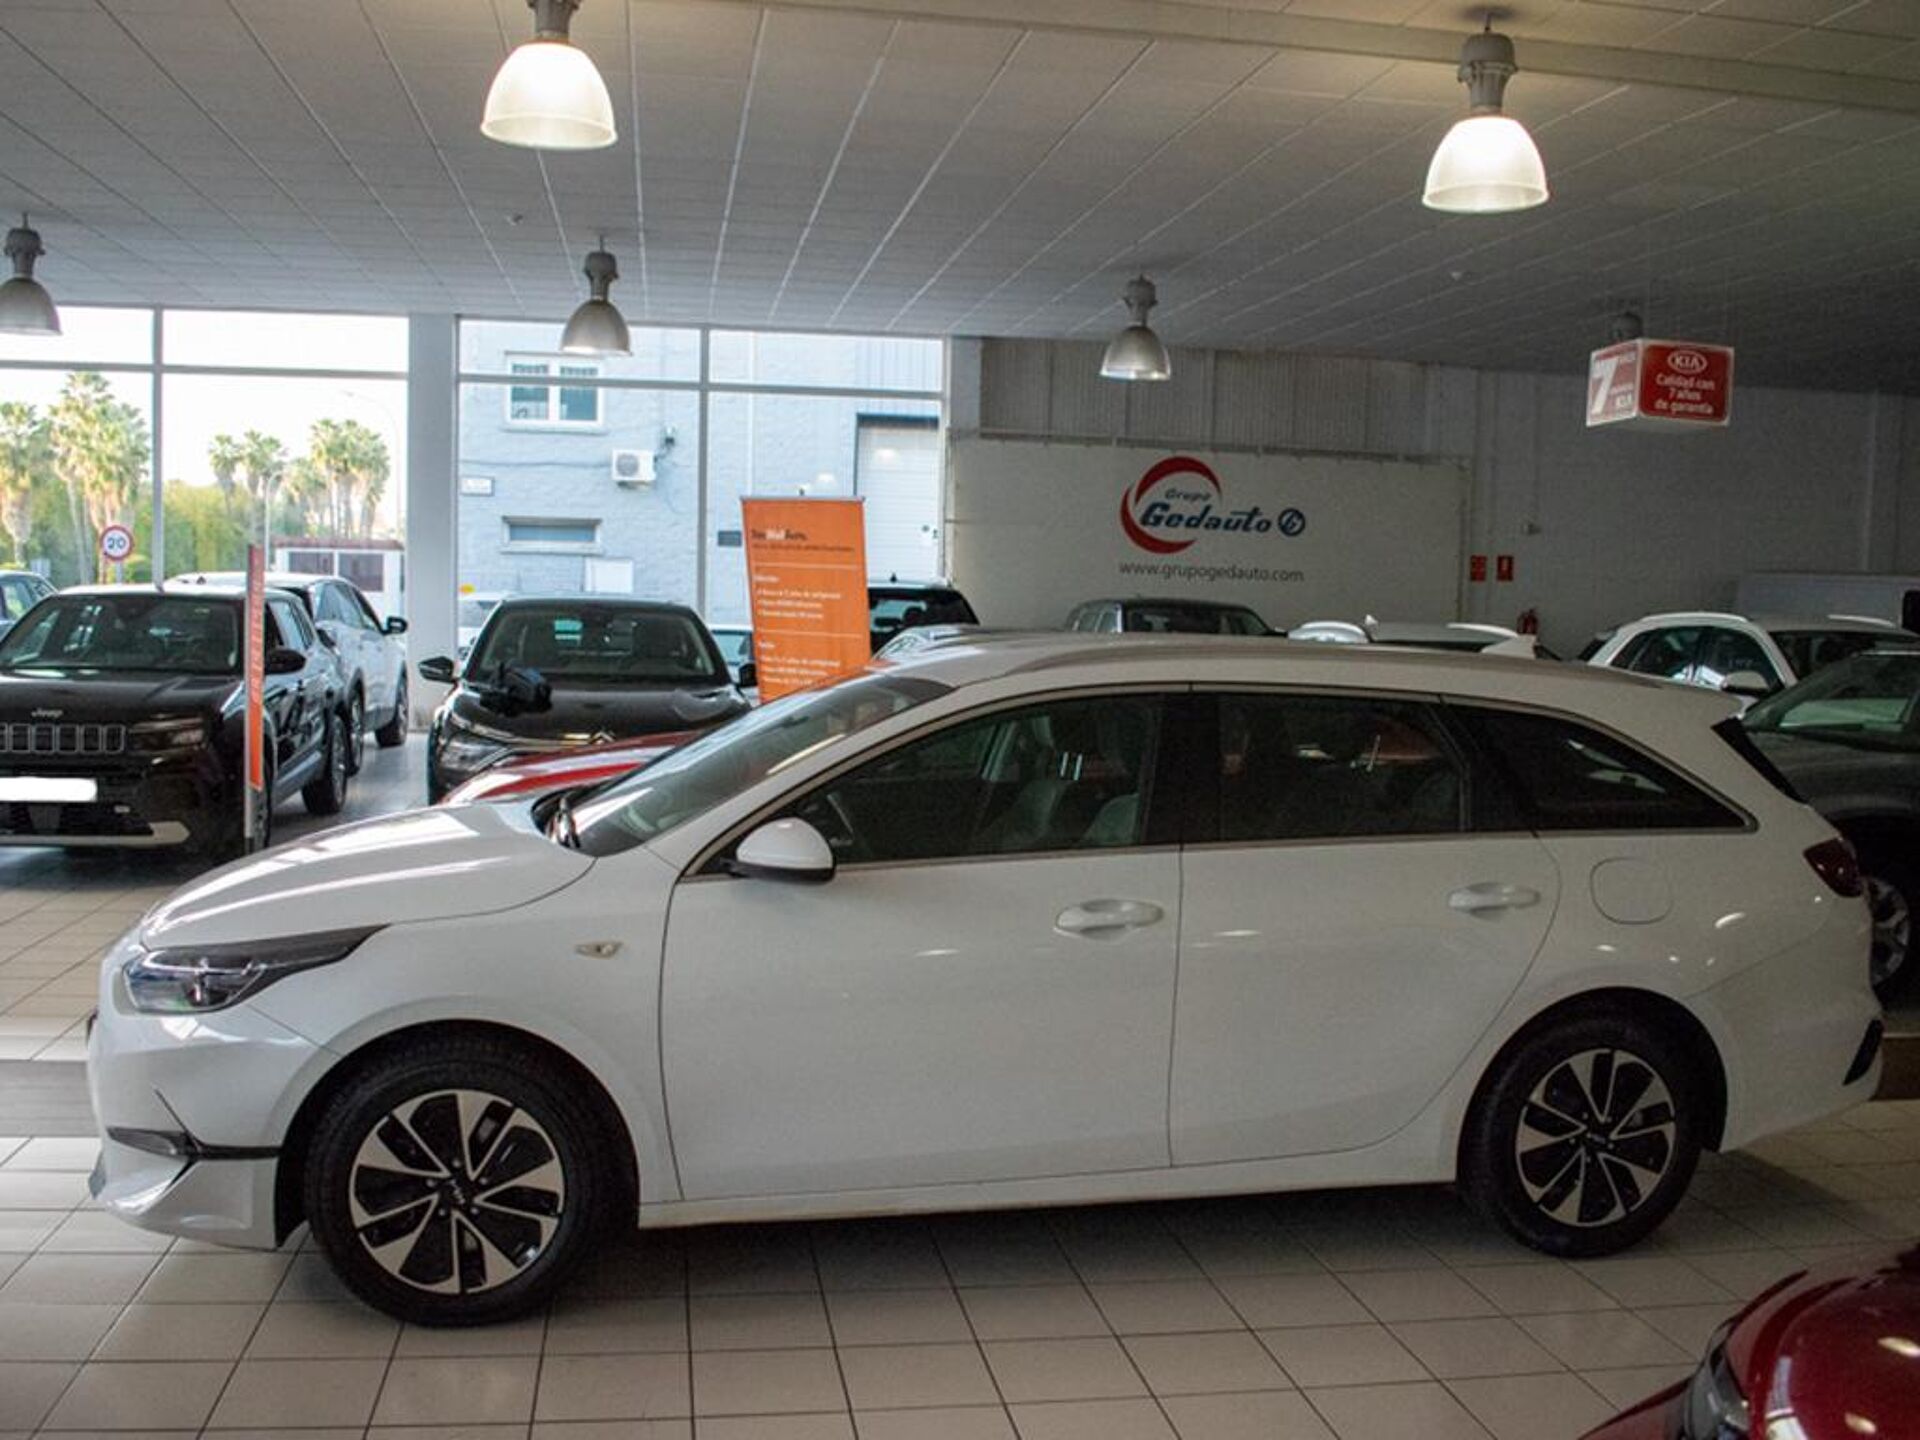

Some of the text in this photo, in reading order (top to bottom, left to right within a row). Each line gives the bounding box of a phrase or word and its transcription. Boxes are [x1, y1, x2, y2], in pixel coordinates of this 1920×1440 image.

[1674, 355, 1700, 368] KIA
[1591, 357, 1618, 416] 7
[1669, 387, 1676, 400] 7
[1654, 399, 1669, 410] de
[1164, 487, 1211, 502] Grupo
[1140, 501, 1272, 534] Gedauto
[107, 536, 127, 549] 20
[1119, 561, 1304, 583] www.grupogedauto.com
[31, 708, 63, 718] Jeep
